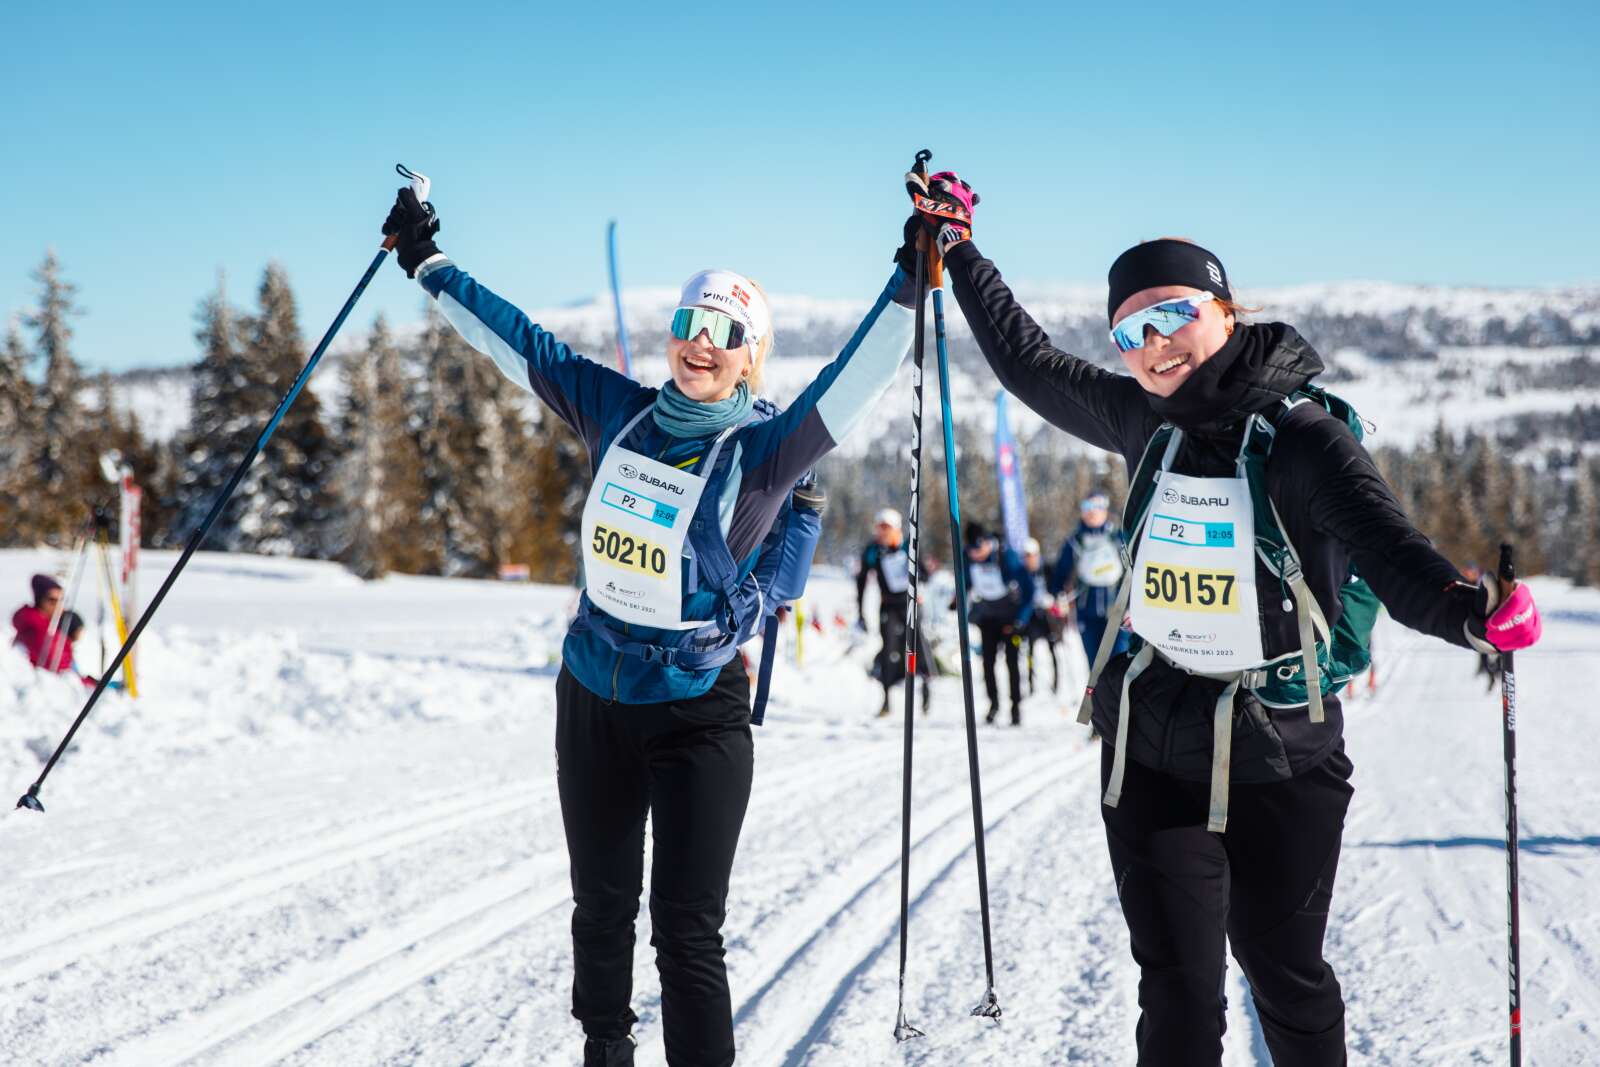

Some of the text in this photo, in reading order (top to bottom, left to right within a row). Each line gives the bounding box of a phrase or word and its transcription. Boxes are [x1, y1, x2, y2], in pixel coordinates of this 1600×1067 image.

[638, 473, 685, 496] SUBARU
[621, 494, 675, 522] P2 12:05
[1180, 494, 1230, 507] SUBARU
[1170, 523, 1233, 539] P2 12:05
[592, 525, 666, 574] 50210
[1144, 566, 1235, 606] 50157
[1201, 648, 1214, 656] SKI
[1217, 648, 1234, 657] 2023
